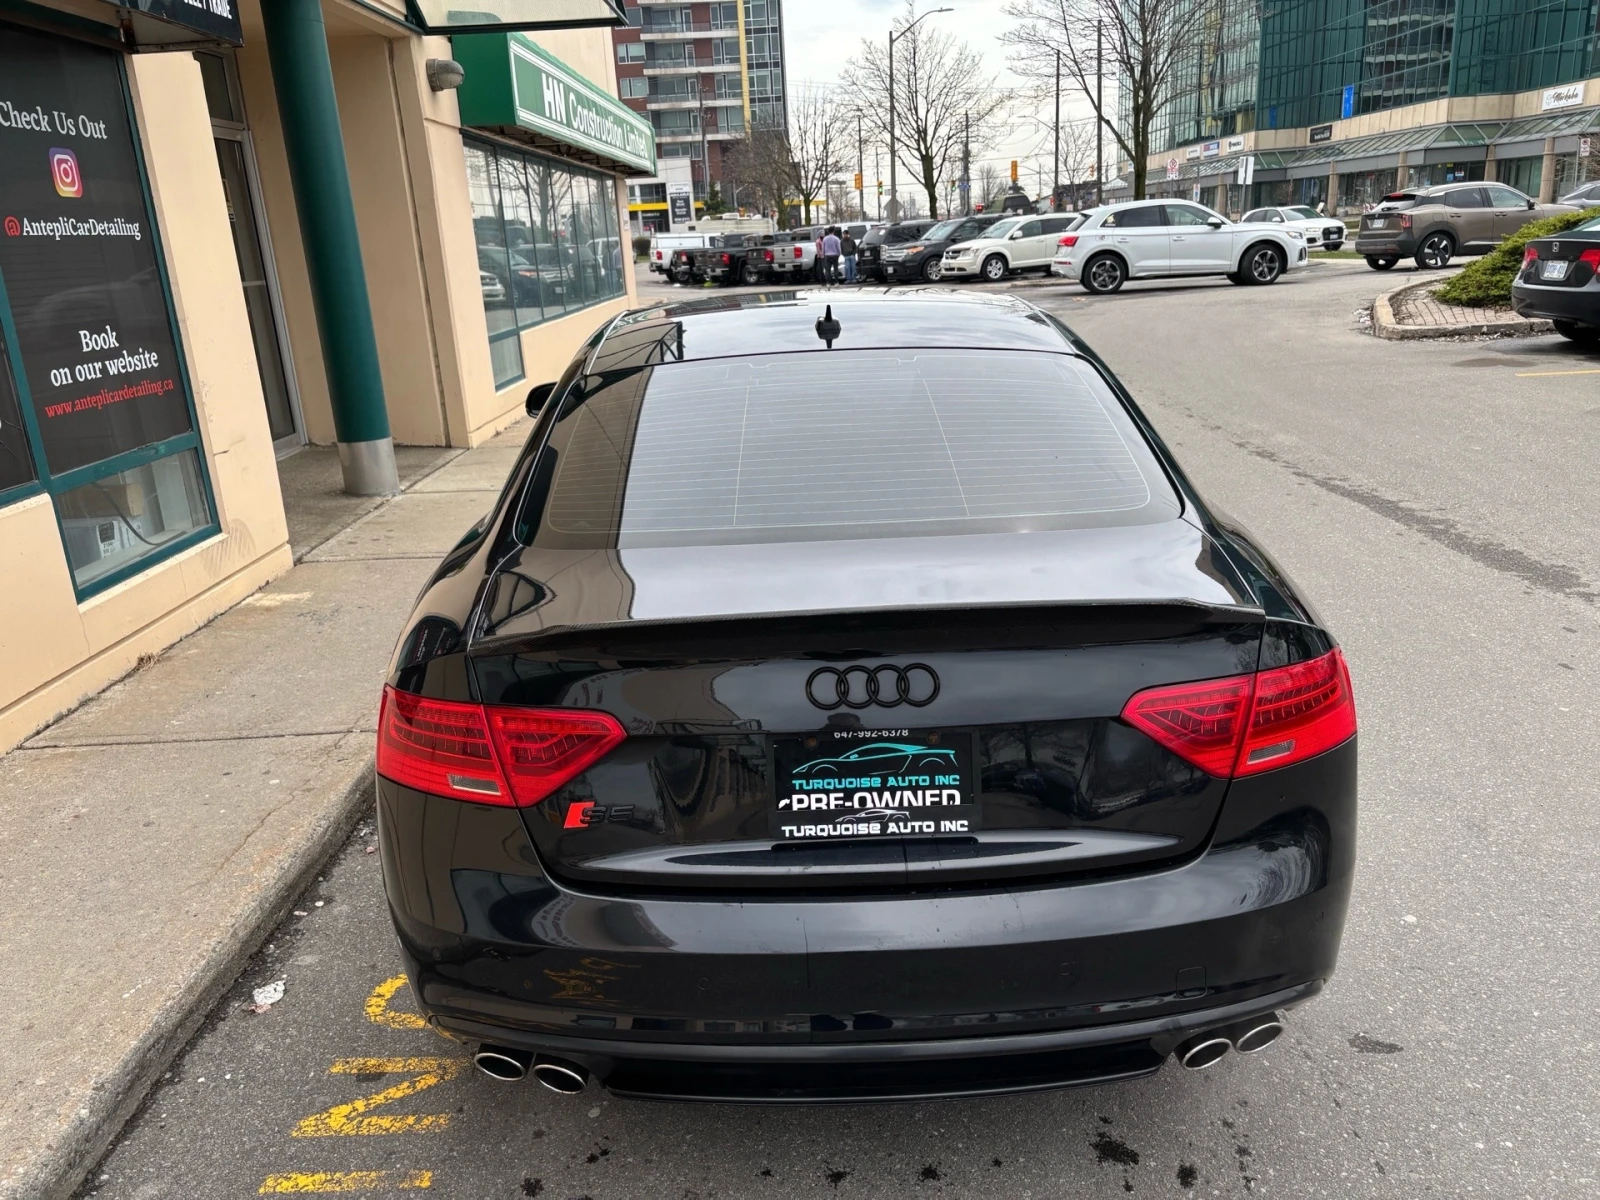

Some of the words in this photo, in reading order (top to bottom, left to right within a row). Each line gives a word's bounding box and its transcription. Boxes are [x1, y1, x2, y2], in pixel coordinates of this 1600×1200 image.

[0, 102, 51, 132] Check
[53, 111, 76, 136] Us
[79, 115, 107, 139] Out
[542, 72, 567, 124] HN
[569, 92, 624, 148] Construction
[623, 123, 648, 158] Limited
[79, 325, 119, 352] Book
[51, 366, 73, 387] on
[75, 360, 102, 382] our
[105, 348, 159, 375] website
[45, 378, 174, 417] www.anteplicardetailing.ca
[887, 775, 930, 787] AUTO
[935, 774, 960, 785] INC
[887, 820, 935, 834] AUTO
[940, 820, 968, 831] INC
